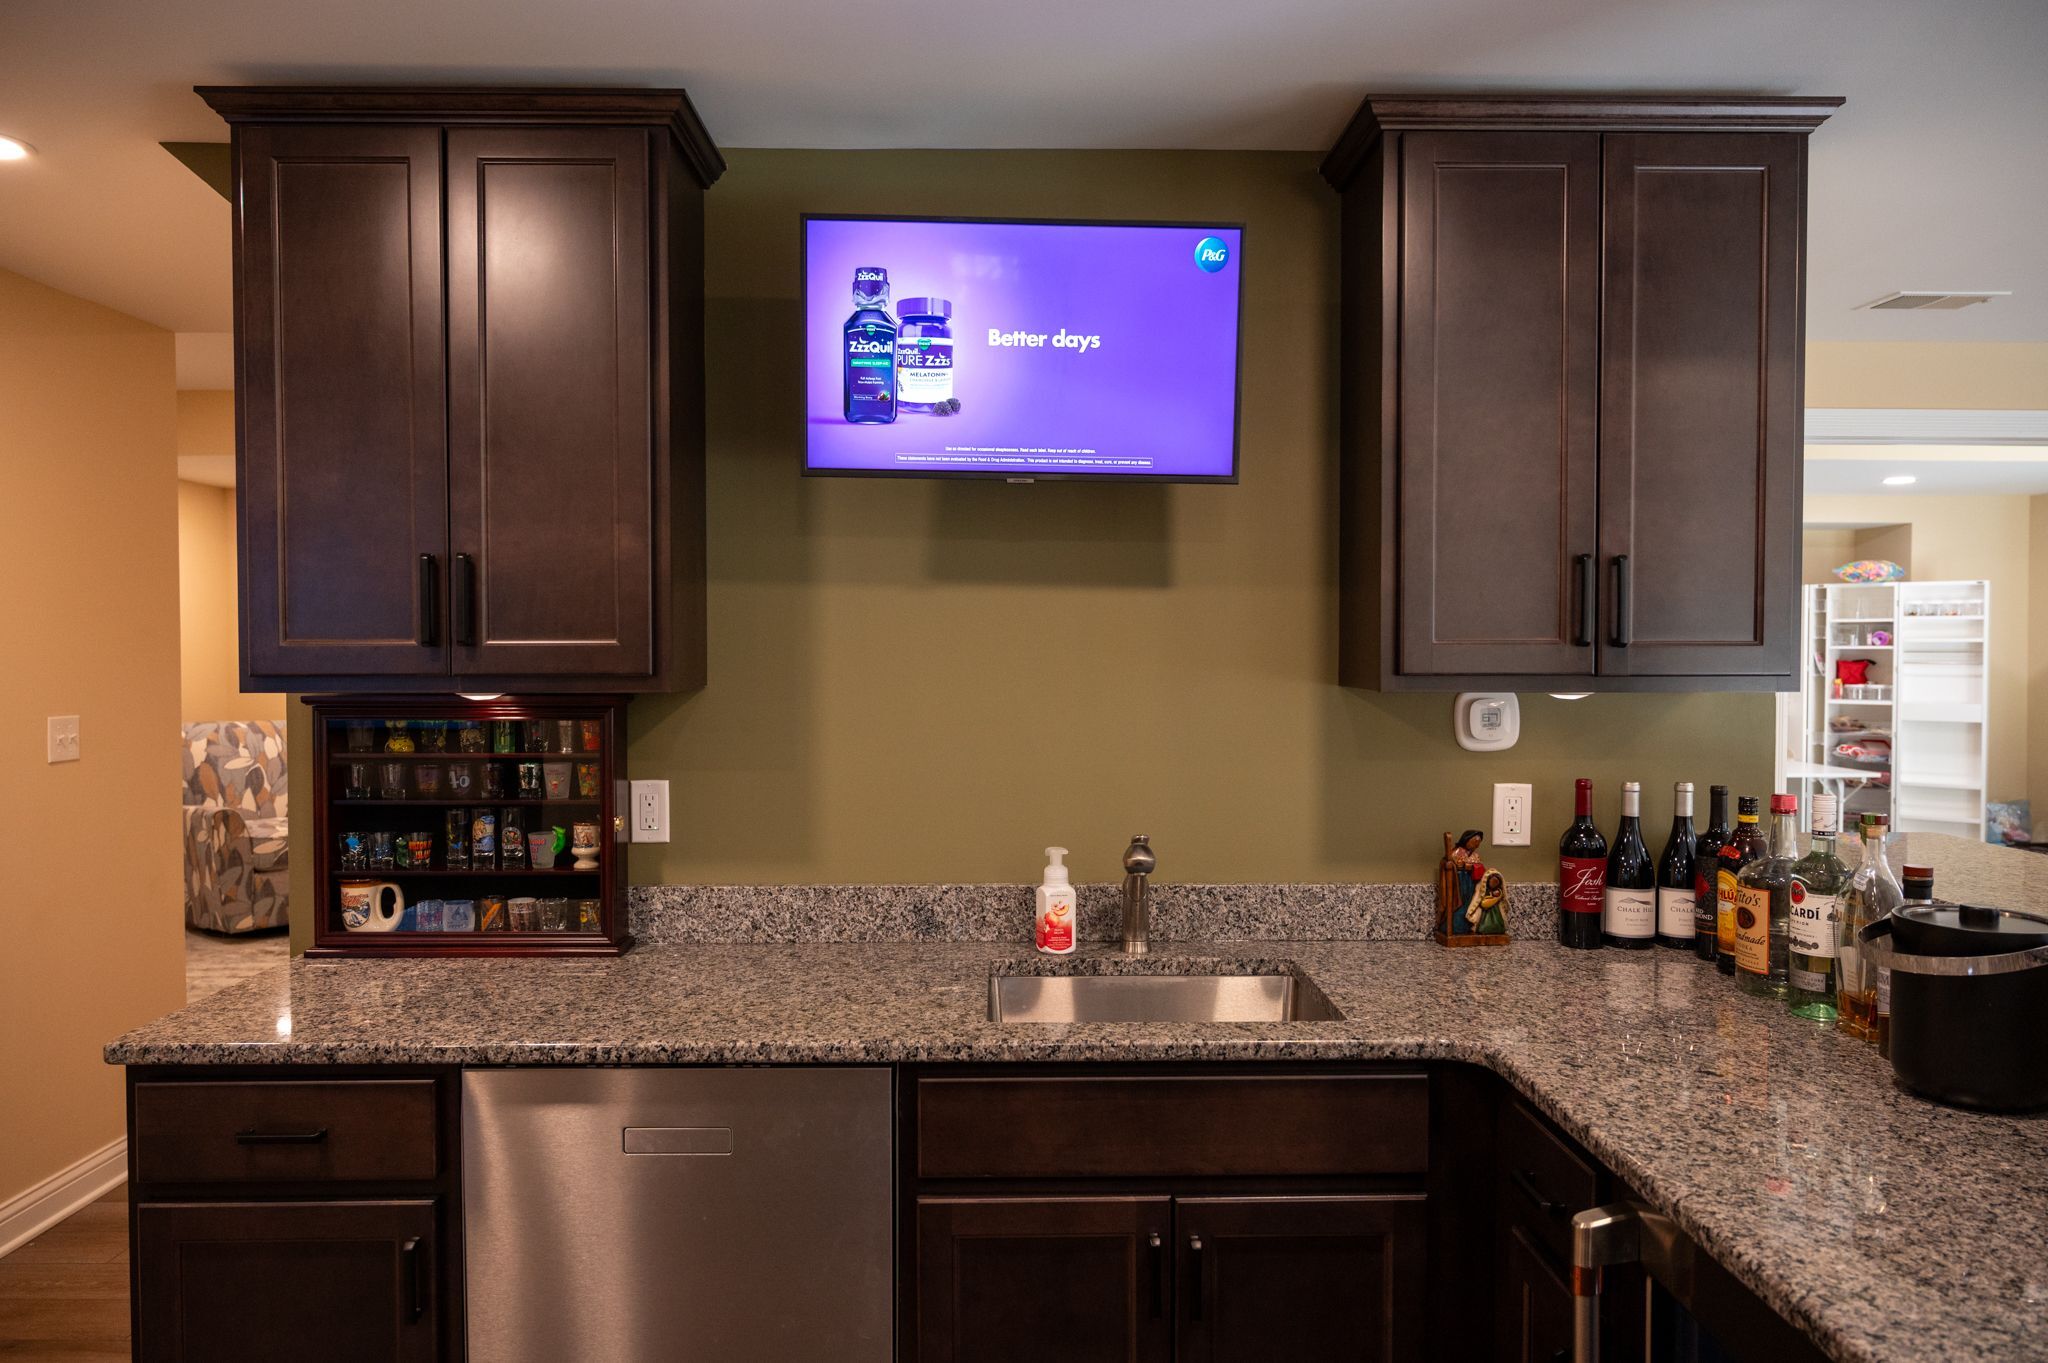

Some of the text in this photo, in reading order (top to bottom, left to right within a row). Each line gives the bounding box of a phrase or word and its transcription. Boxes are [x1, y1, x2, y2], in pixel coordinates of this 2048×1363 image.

[1202, 249, 1225, 262] P&G
[858, 272, 884, 282] ZzzQuil
[849, 340, 893, 354] ZzzQuil
[988, 328, 1100, 352] Better days
[898, 355, 950, 366] PURE Zzzs
[449, 771, 470, 788] 40
[1563, 866, 1604, 897] Josh
[1719, 889, 1736, 902] HLÚ
[1791, 905, 1820, 920] CARDÍ
